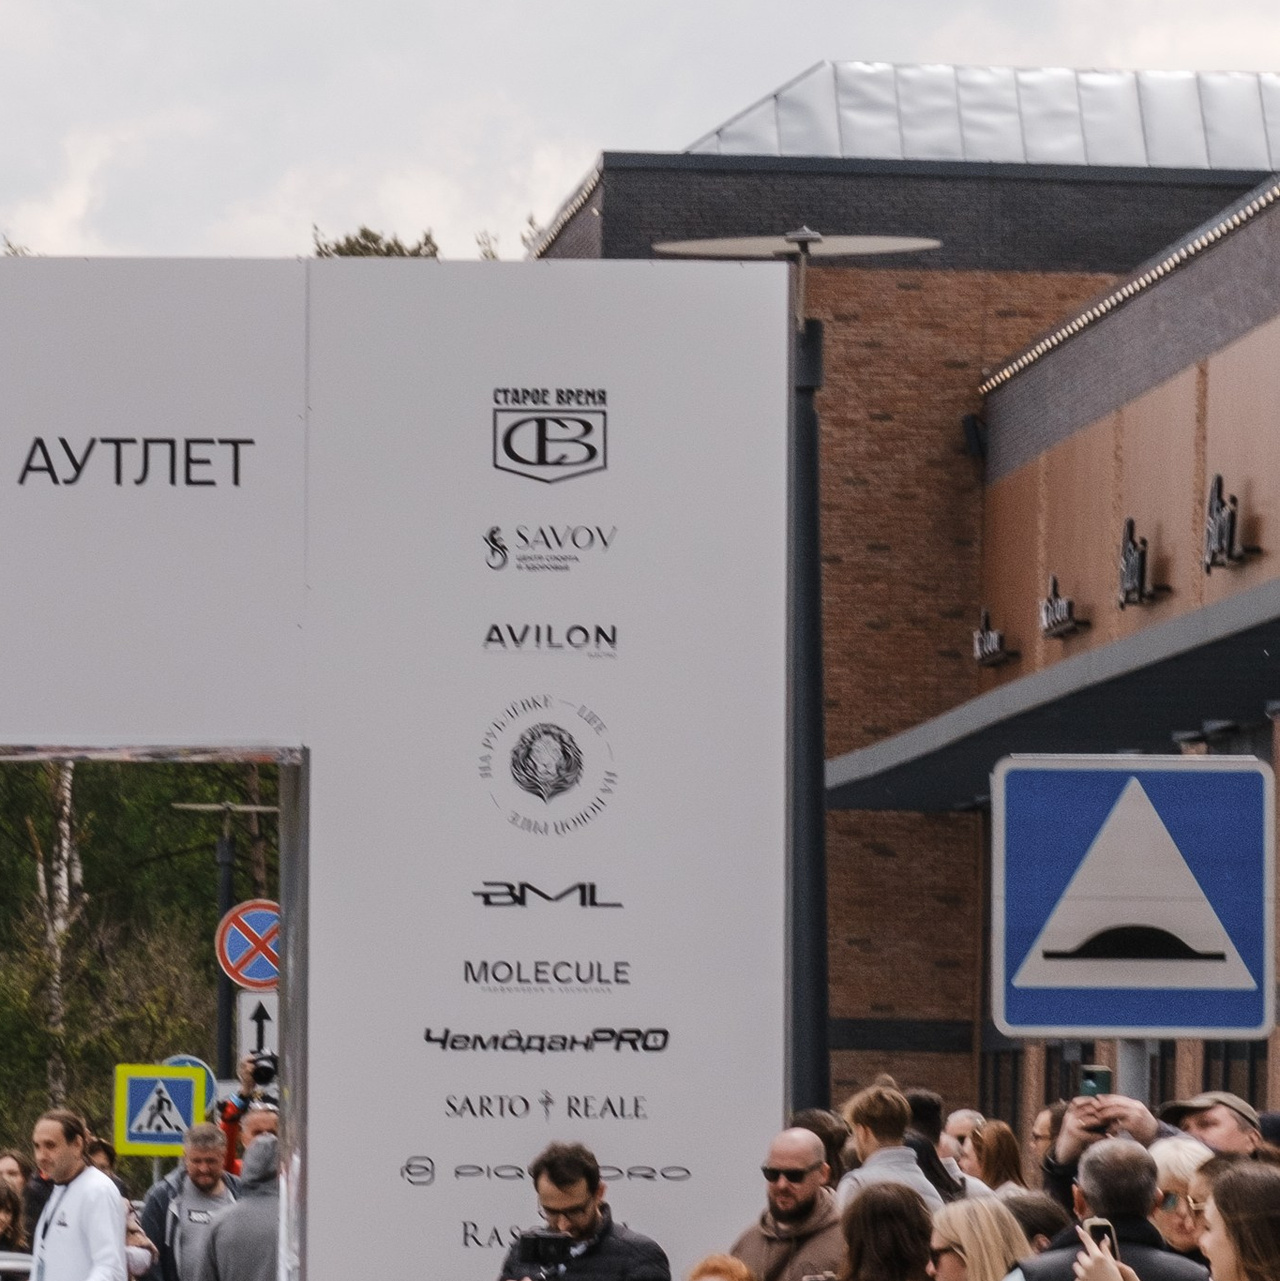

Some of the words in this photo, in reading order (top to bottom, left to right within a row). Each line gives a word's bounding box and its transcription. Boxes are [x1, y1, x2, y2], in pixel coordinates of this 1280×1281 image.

[493, 388, 550, 405] СТАРОЕ
[556, 389, 607, 406] ВРЕМЯ
[17, 437, 255, 487] АУТЛЕТ
[484, 624, 617, 649] AVILON
[464, 960, 630, 985] MOLECULE
[445, 1095, 530, 1118] SARTO
[567, 1096, 647, 1119] REALE
